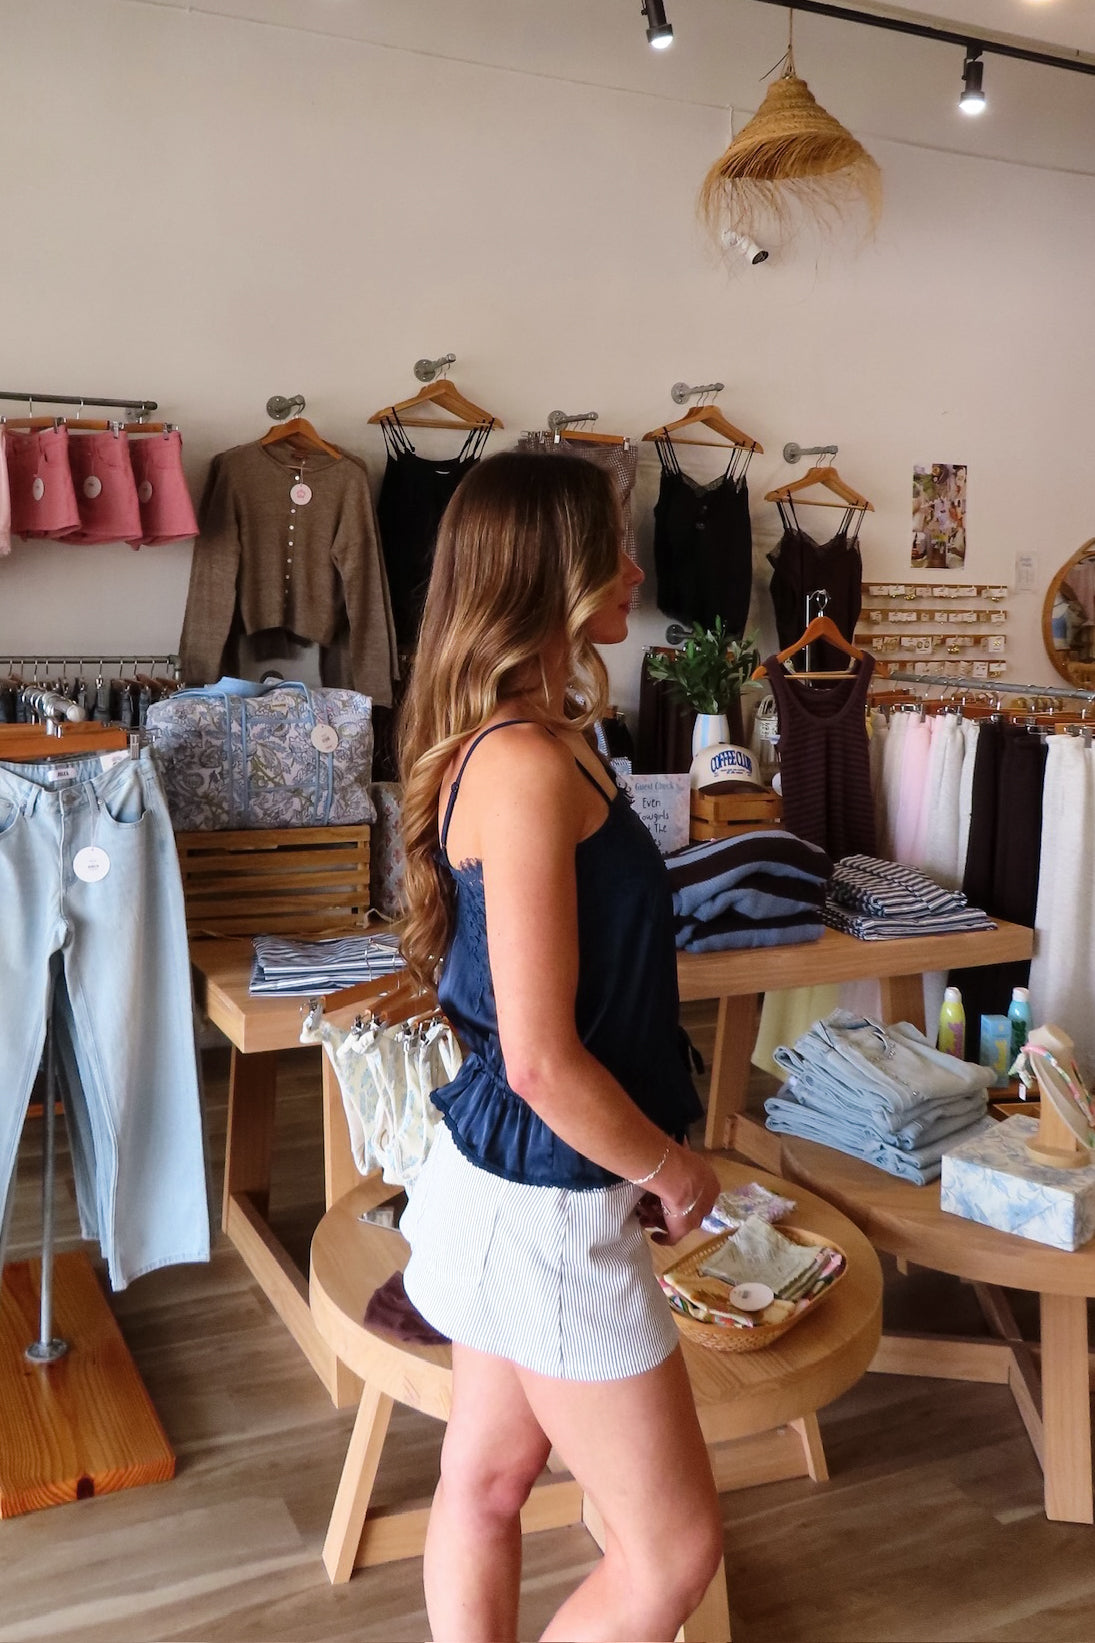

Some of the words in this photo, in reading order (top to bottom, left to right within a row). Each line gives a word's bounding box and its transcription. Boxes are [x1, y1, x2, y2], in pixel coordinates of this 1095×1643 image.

[711, 750, 736, 773] COFFEE
[642, 797, 661, 809] Even
[654, 823, 668, 834] The
